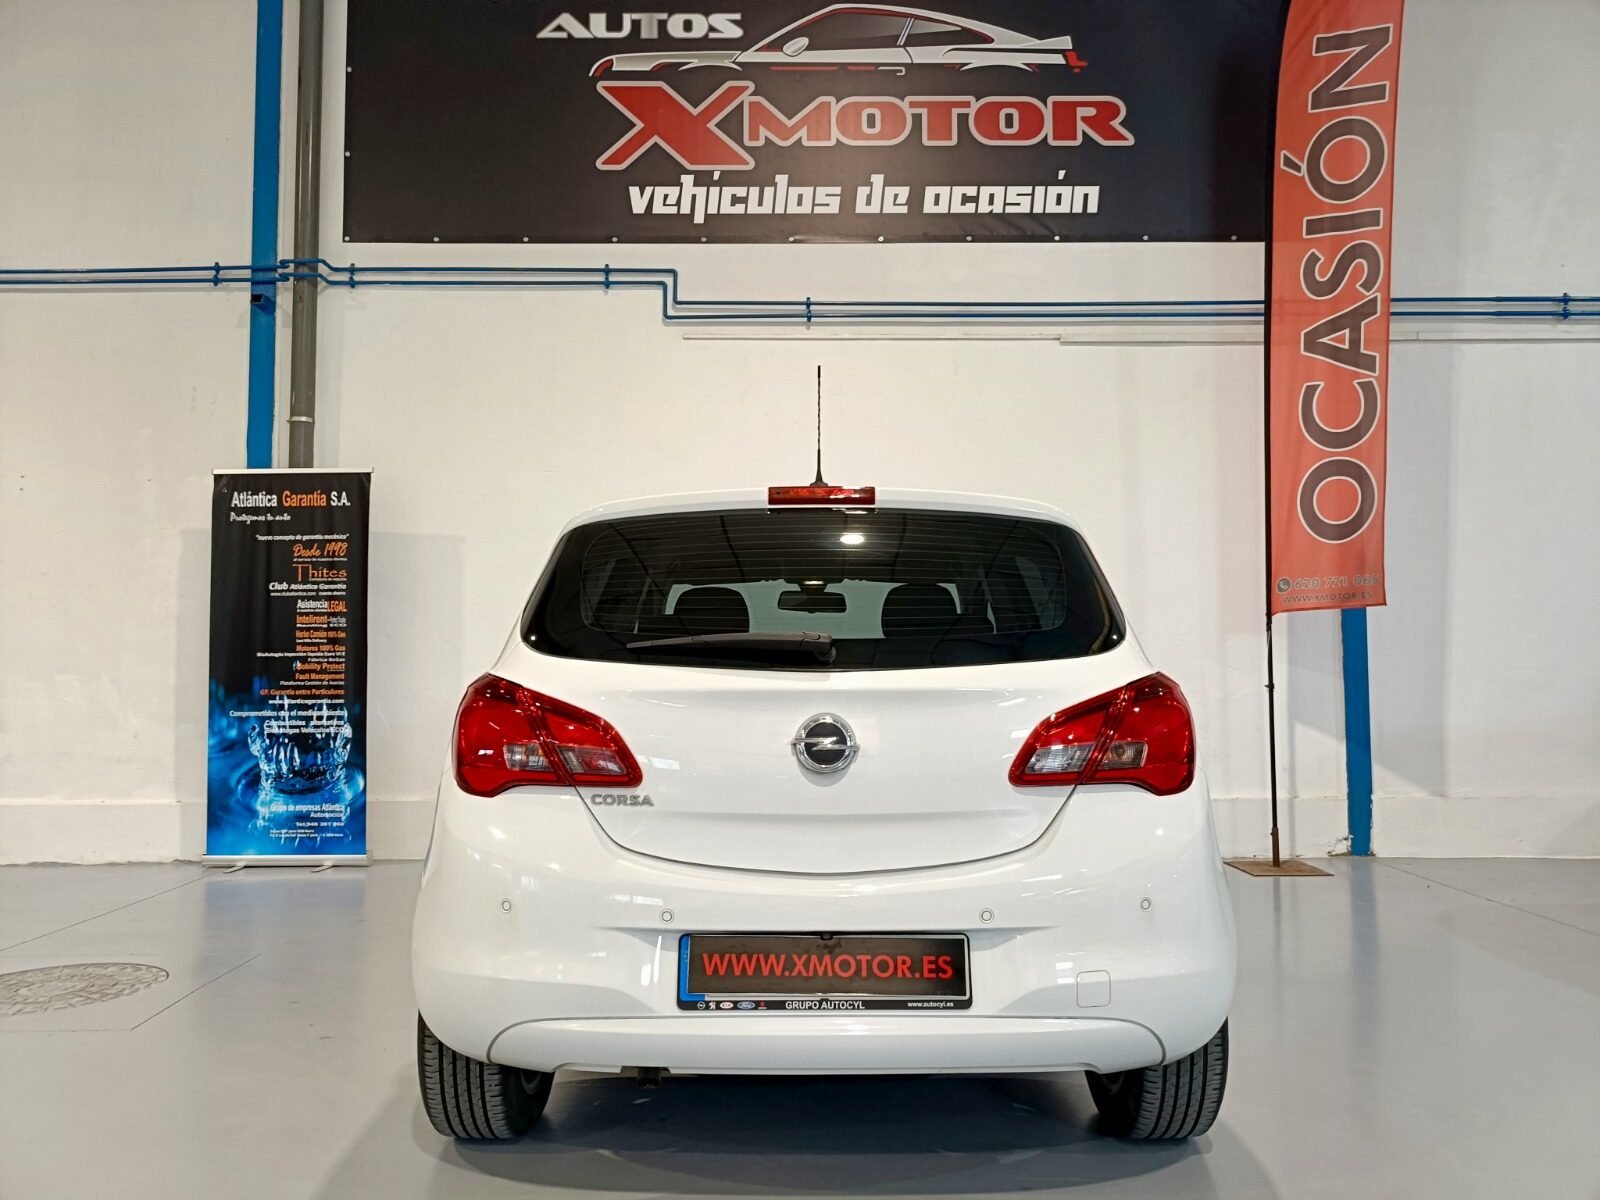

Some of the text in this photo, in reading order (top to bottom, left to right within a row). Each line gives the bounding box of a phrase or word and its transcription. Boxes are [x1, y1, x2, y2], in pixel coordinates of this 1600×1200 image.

[536, 12, 744, 39] AUTOS
[596, 81, 1135, 170] XMOTOR
[628, 169, 1100, 224] vehículos de ocasión
[1280, 23, 1393, 544] OCASIÓN
[231, 490, 351, 507] Atlántica Garantía S.A.
[292, 542, 348, 557] Desde 1998
[268, 582, 289, 590] Club
[322, 662, 345, 670] Protect
[590, 794, 655, 807] CORSA
[702, 952, 953, 979] WWW.XMOTOR.ES
[785, 1001, 865, 1010] GRUPO AUTOCYL
